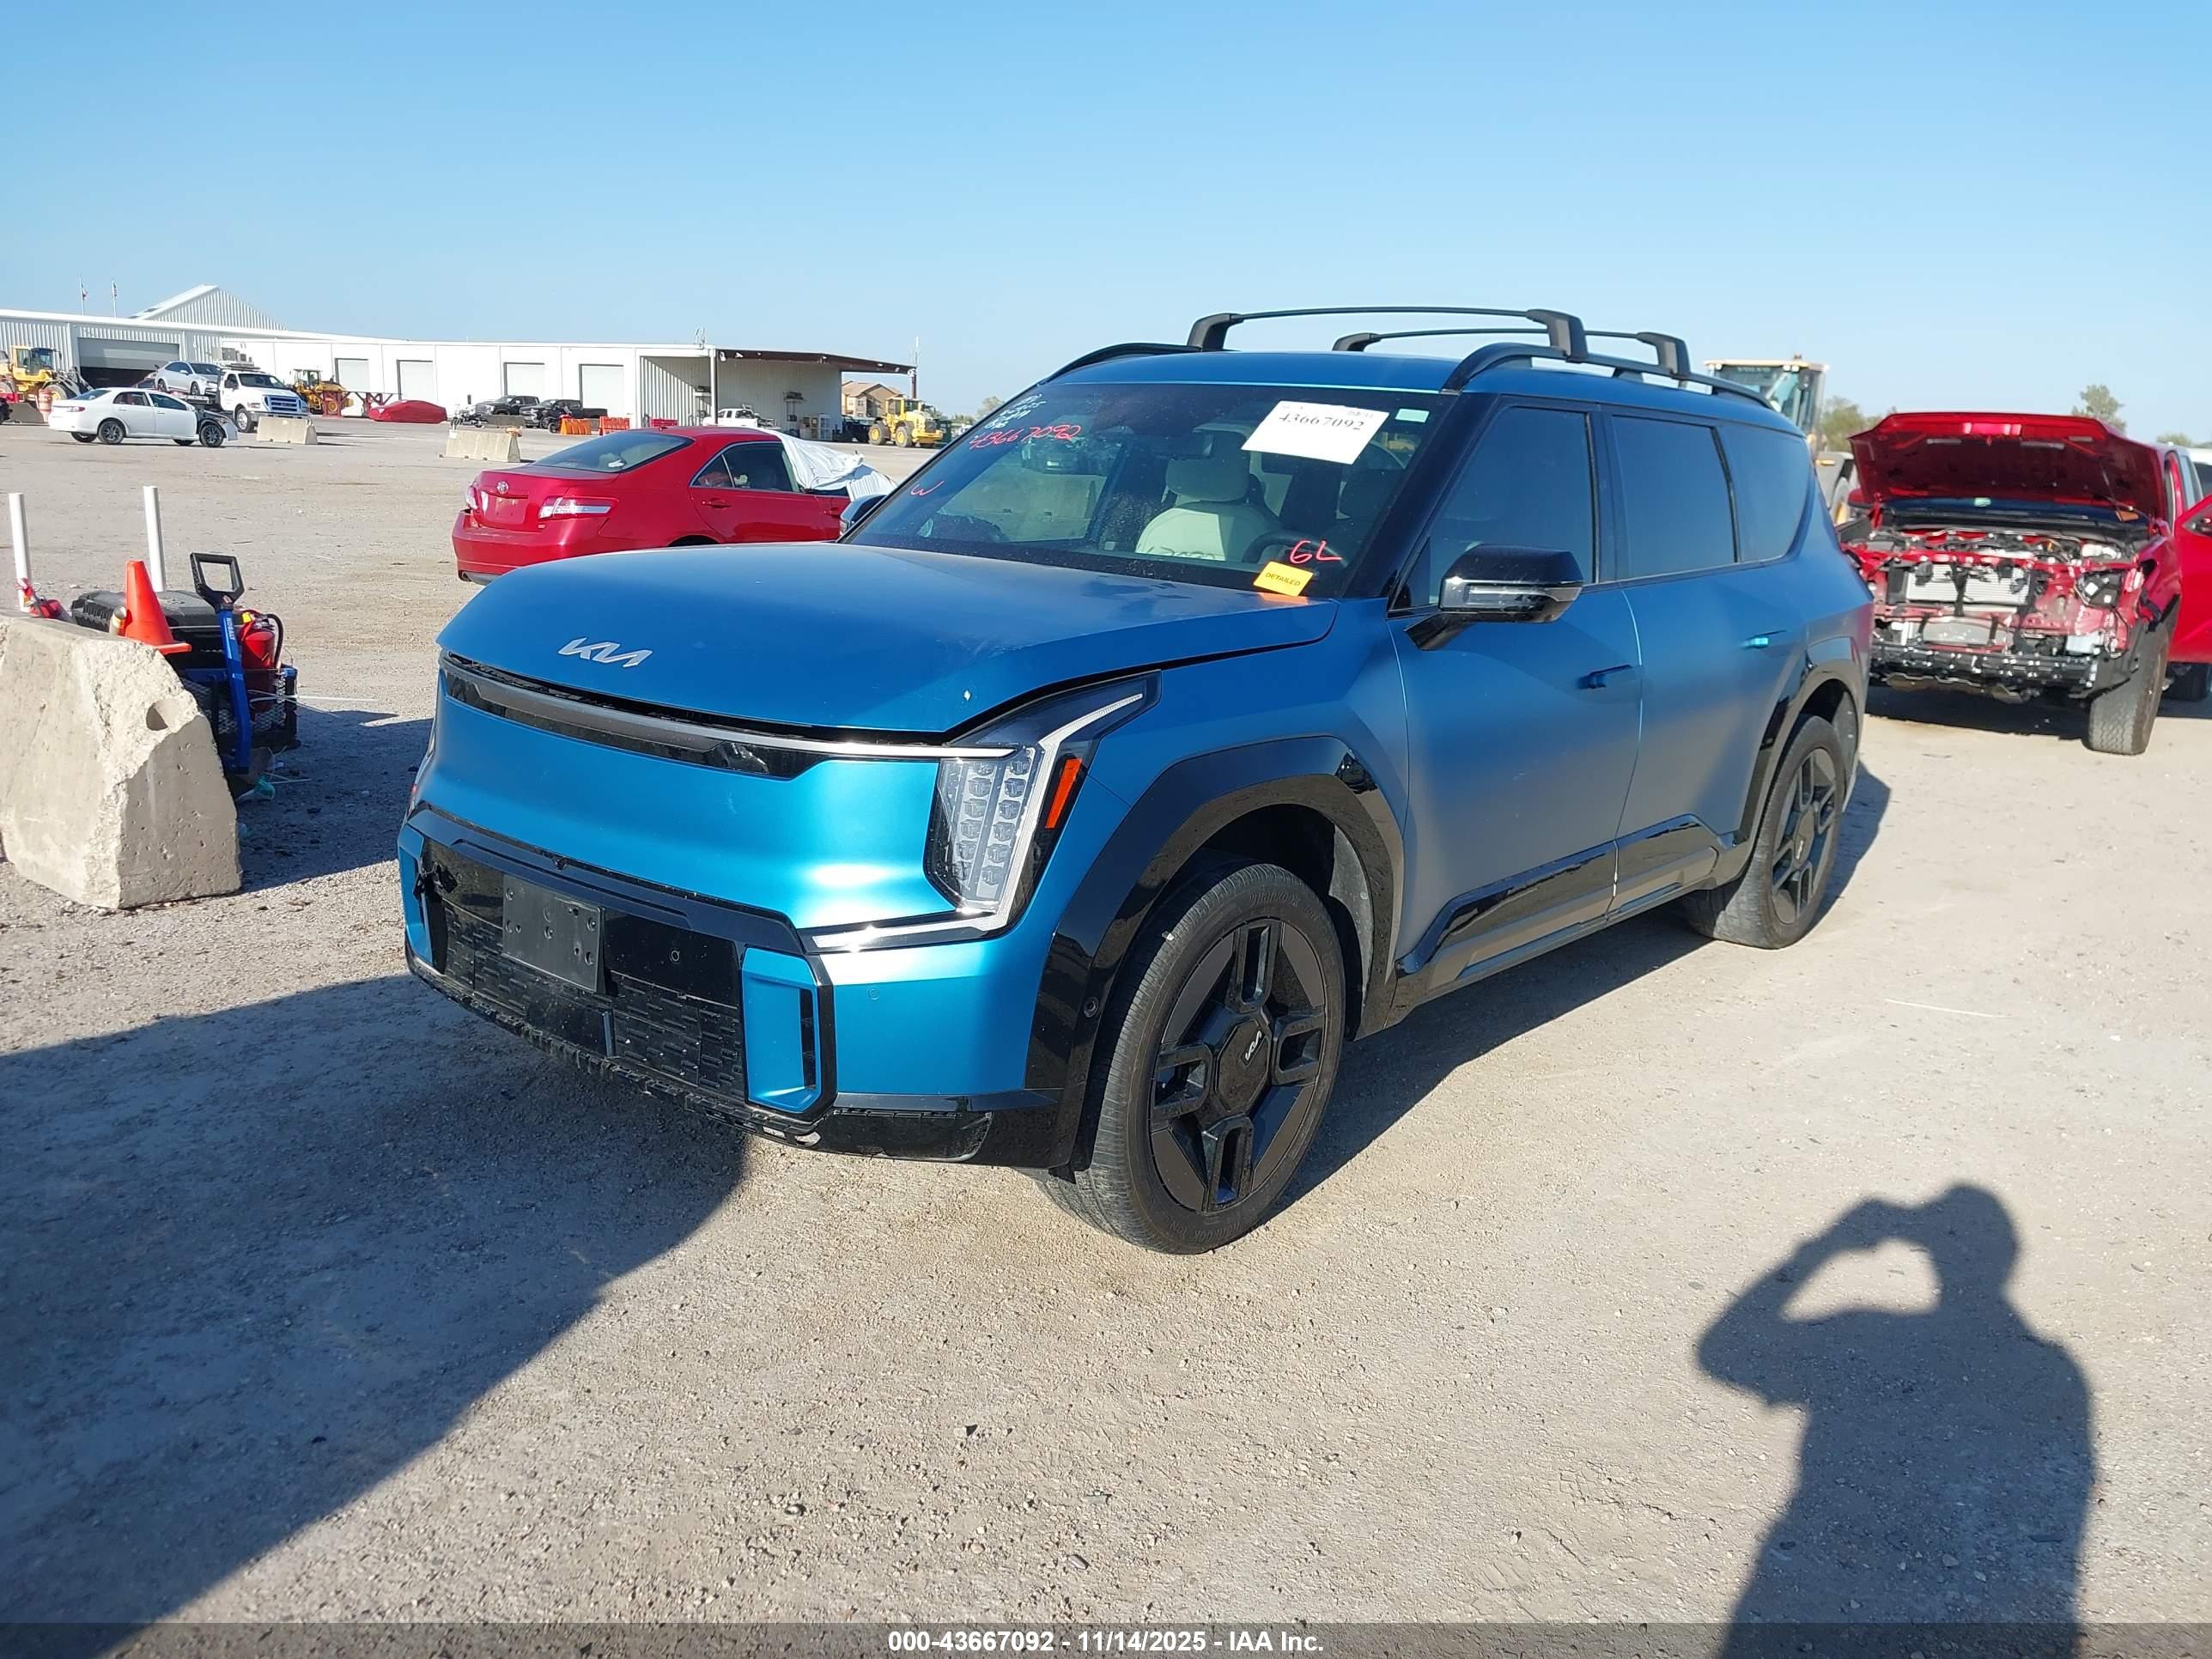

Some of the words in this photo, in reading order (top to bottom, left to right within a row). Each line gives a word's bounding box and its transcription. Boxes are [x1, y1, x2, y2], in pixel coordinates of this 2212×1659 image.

[1279, 412, 1365, 430] 43667092
[1265, 572, 1301, 586] DETAILED
[557, 637, 653, 668] KIA
